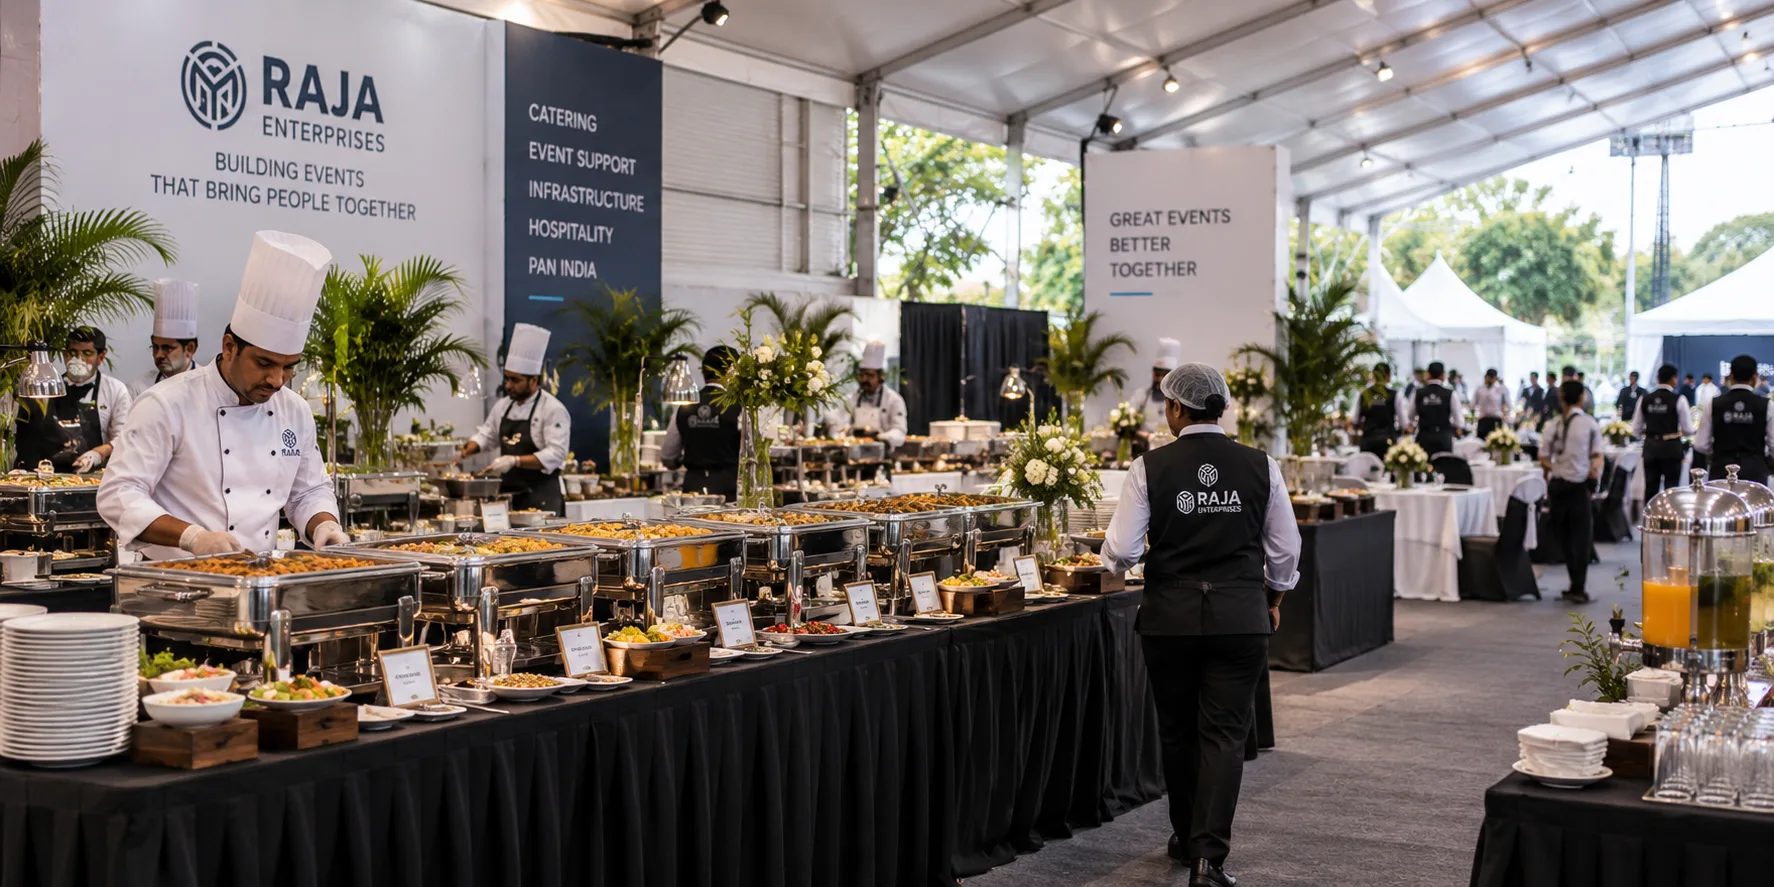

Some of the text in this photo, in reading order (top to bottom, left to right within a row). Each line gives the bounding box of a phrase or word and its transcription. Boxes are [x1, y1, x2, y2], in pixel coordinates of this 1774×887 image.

[262, 55, 384, 124] RAJA
[528, 102, 598, 133] CATERING
[262, 115, 385, 153] ENTERPRISES
[215, 151, 365, 188] BUILDING EVENTS
[529, 140, 637, 176] EVENT SUPPORT
[150, 173, 416, 221] THAT BRING PEOPLE TOGETHER
[529, 179, 645, 213] INFRASTRUCTURE
[528, 217, 614, 244] HOSPITALITY
[1109, 208, 1232, 228] GREAT EVENTS
[1109, 235, 1171, 253] BETTER
[528, 256, 598, 280] PAN INDIA
[1109, 260, 1197, 278] TOGETHER
[1197, 490, 1242, 505] RAJA
